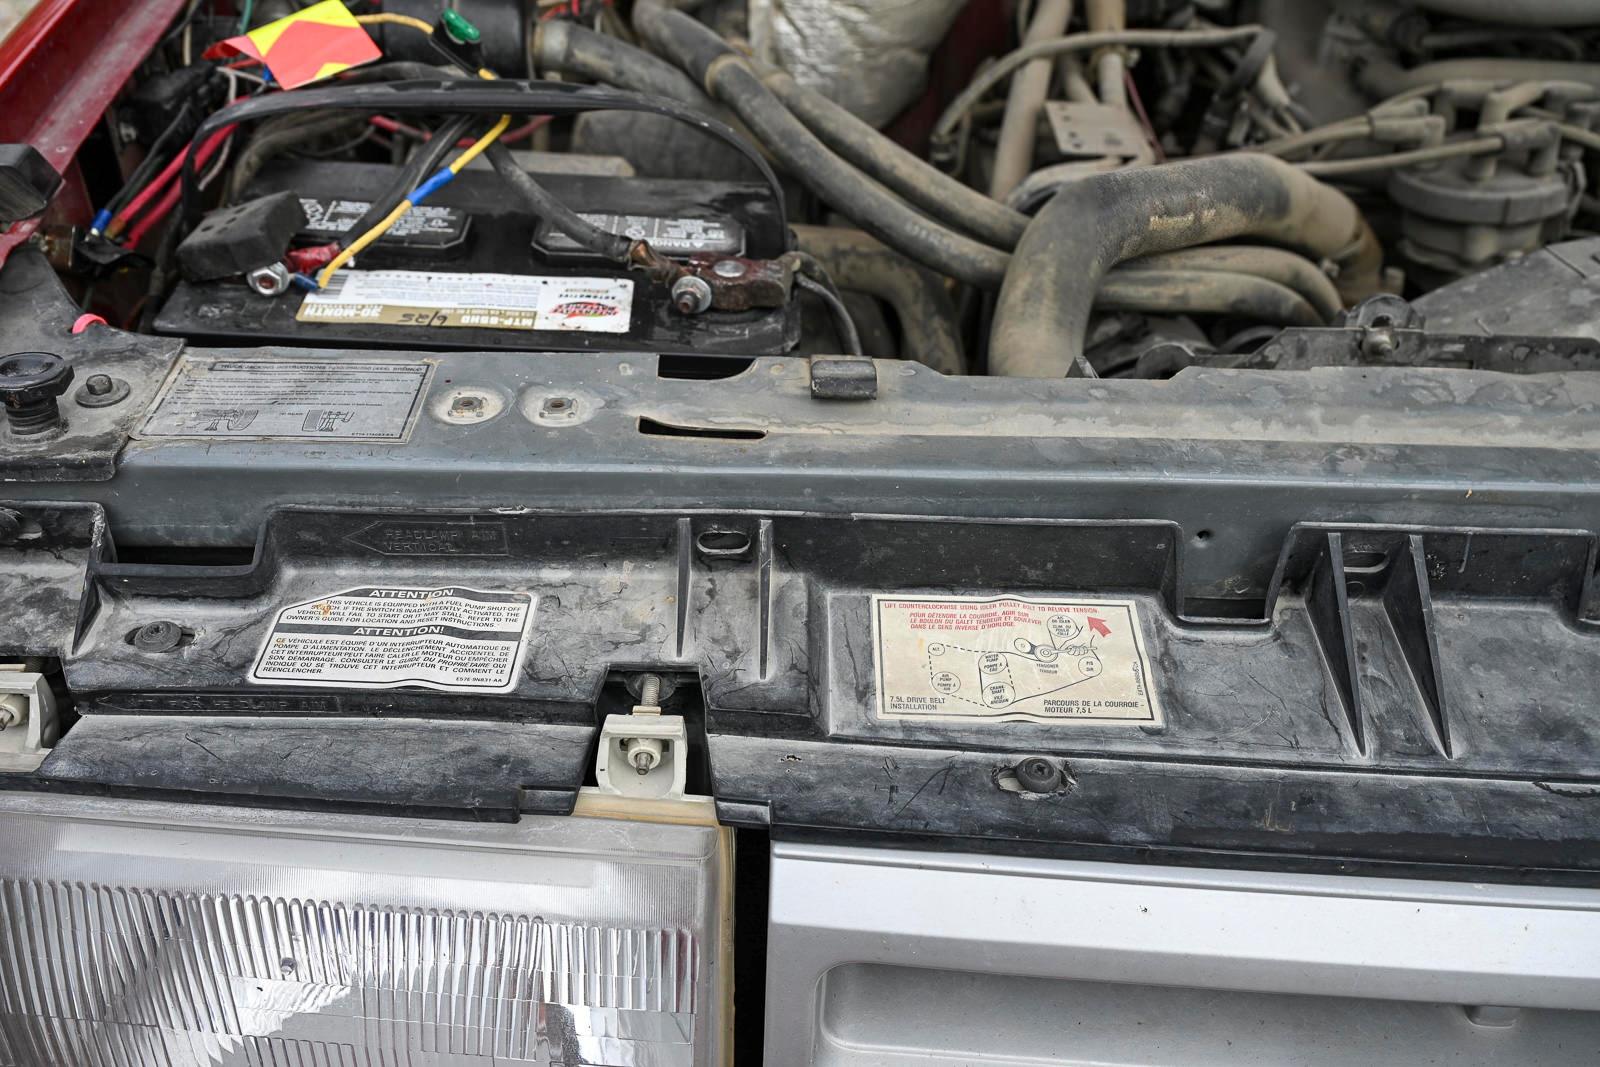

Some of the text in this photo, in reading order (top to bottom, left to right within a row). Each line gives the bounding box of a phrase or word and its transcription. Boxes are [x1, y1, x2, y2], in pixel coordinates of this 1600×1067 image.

[465, 603, 486, 611] PUMP
[440, 617, 496, 627] INSTRUCTIONS.
[354, 626, 444, 636] ATTENTION!
[390, 639, 443, 647] INTERRUPTEUR
[445, 641, 499, 651] AUTOMATIQUE
[421, 651, 453, 660] MOTEUR
[450, 648, 495, 657] ACCIDENTEL
[399, 656, 421, 664] GUIDE
[382, 662, 436, 671] INTERRUPTEUR
[1043, 699, 1079, 707] PARCOURS
